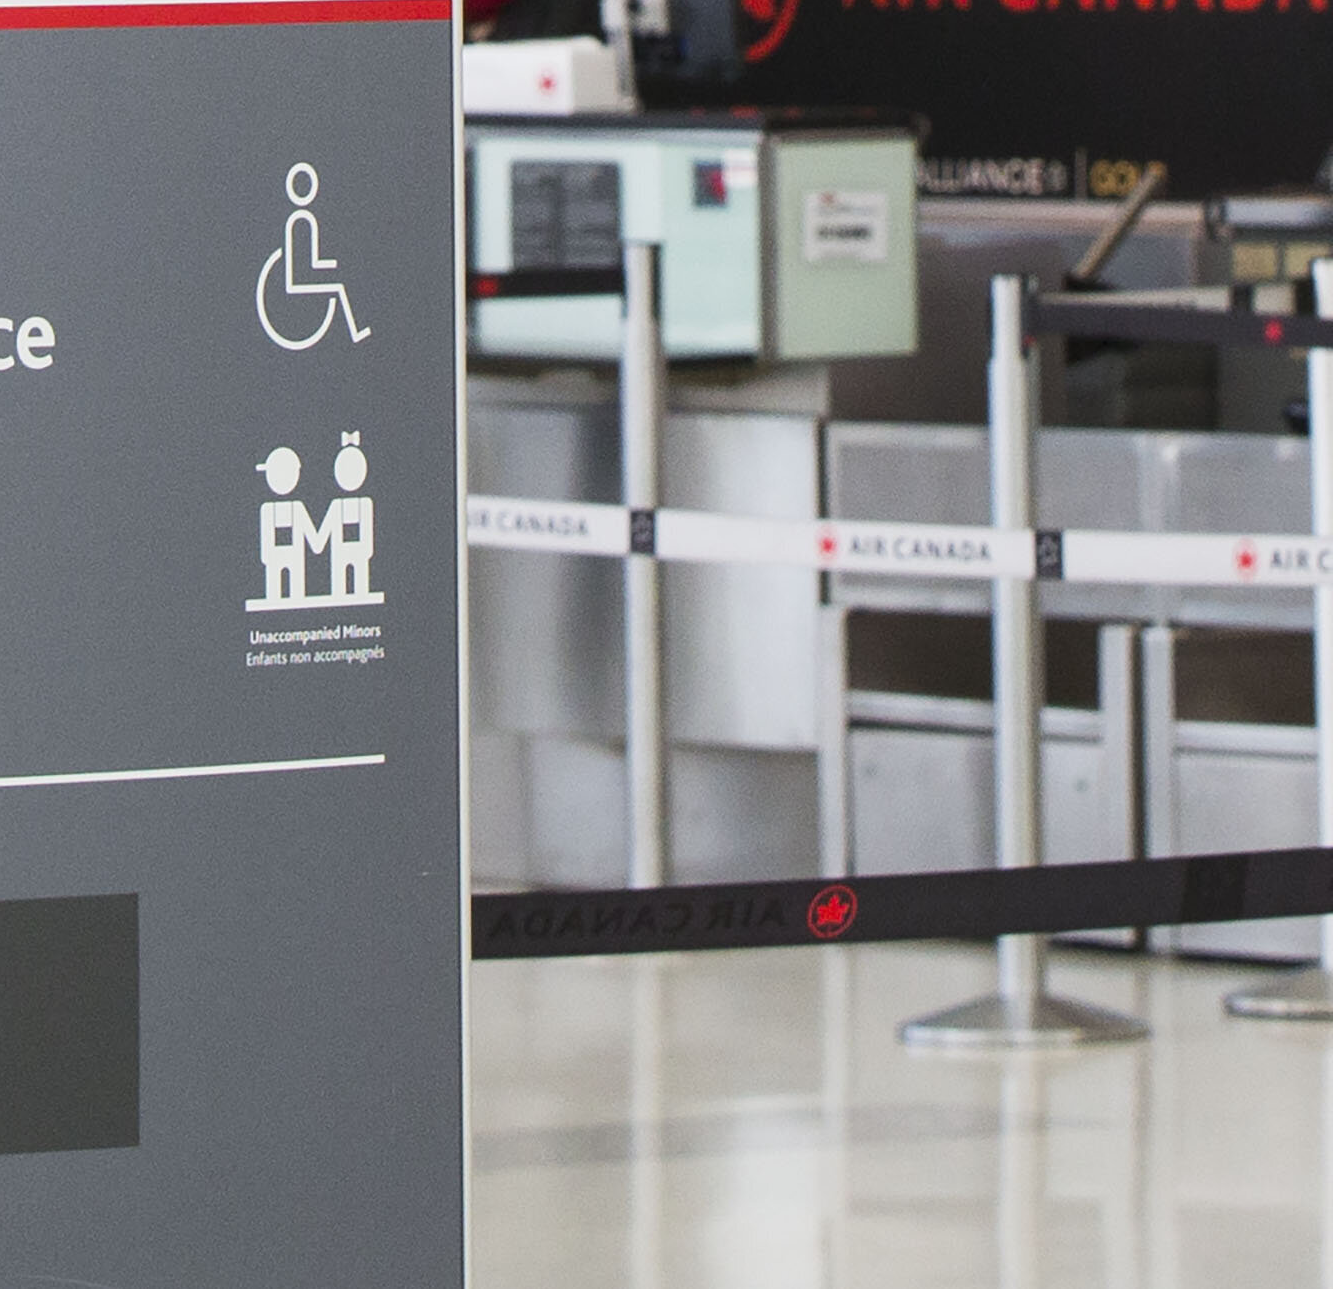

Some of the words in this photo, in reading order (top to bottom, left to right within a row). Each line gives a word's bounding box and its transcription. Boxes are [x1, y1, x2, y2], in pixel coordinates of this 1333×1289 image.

[1089, 158, 1167, 198] GO
[892, 536, 993, 563] CANADA
[249, 624, 341, 646] Unaccompanied
[342, 623, 382, 639] Minors
[245, 651, 288, 667] Enfants
[289, 652, 311, 664] non
[313, 644, 386, 664] accompagnés
